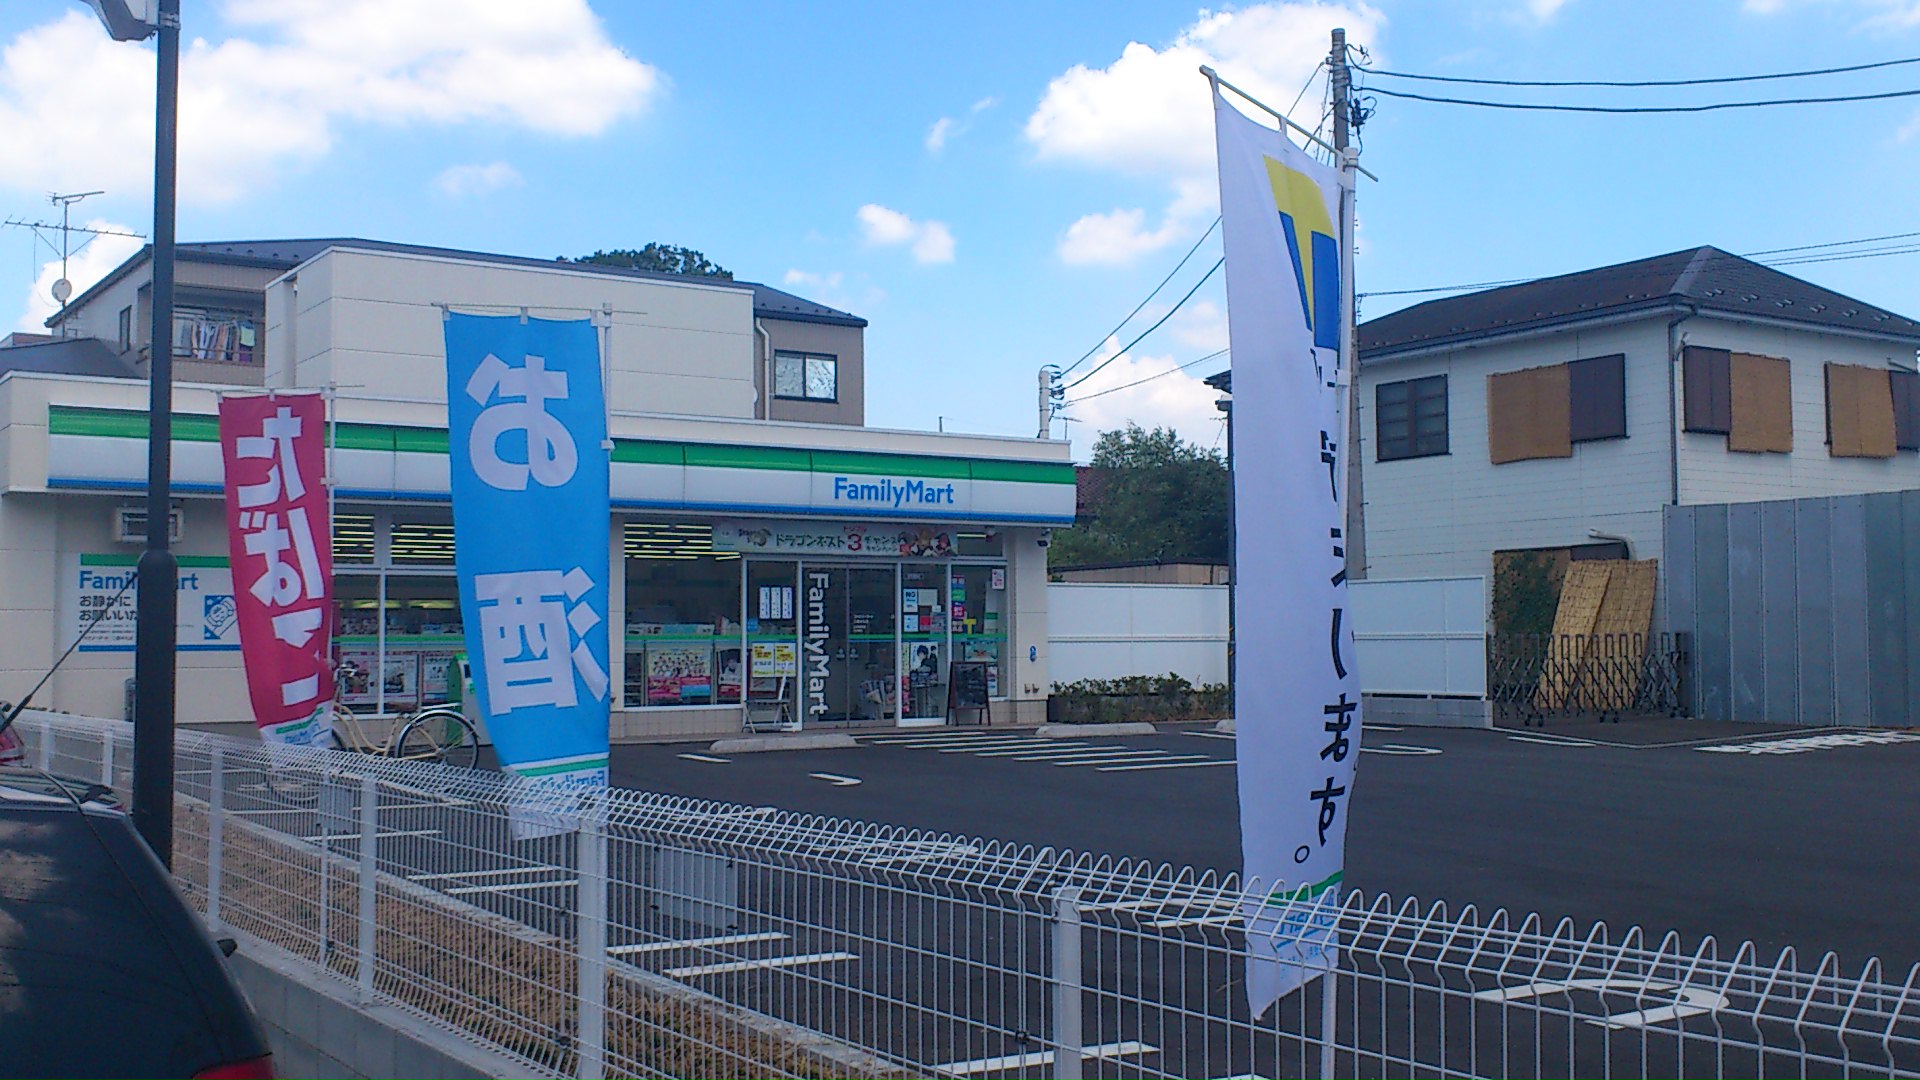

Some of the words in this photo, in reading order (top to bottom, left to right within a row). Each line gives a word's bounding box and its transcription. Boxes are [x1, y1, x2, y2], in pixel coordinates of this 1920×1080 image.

[834, 477, 954, 508] FamilyMart
[776, 533, 845, 548] ドラゴンネスト
[847, 533, 862, 551] 3
[804, 573, 829, 715] FamilyMart
